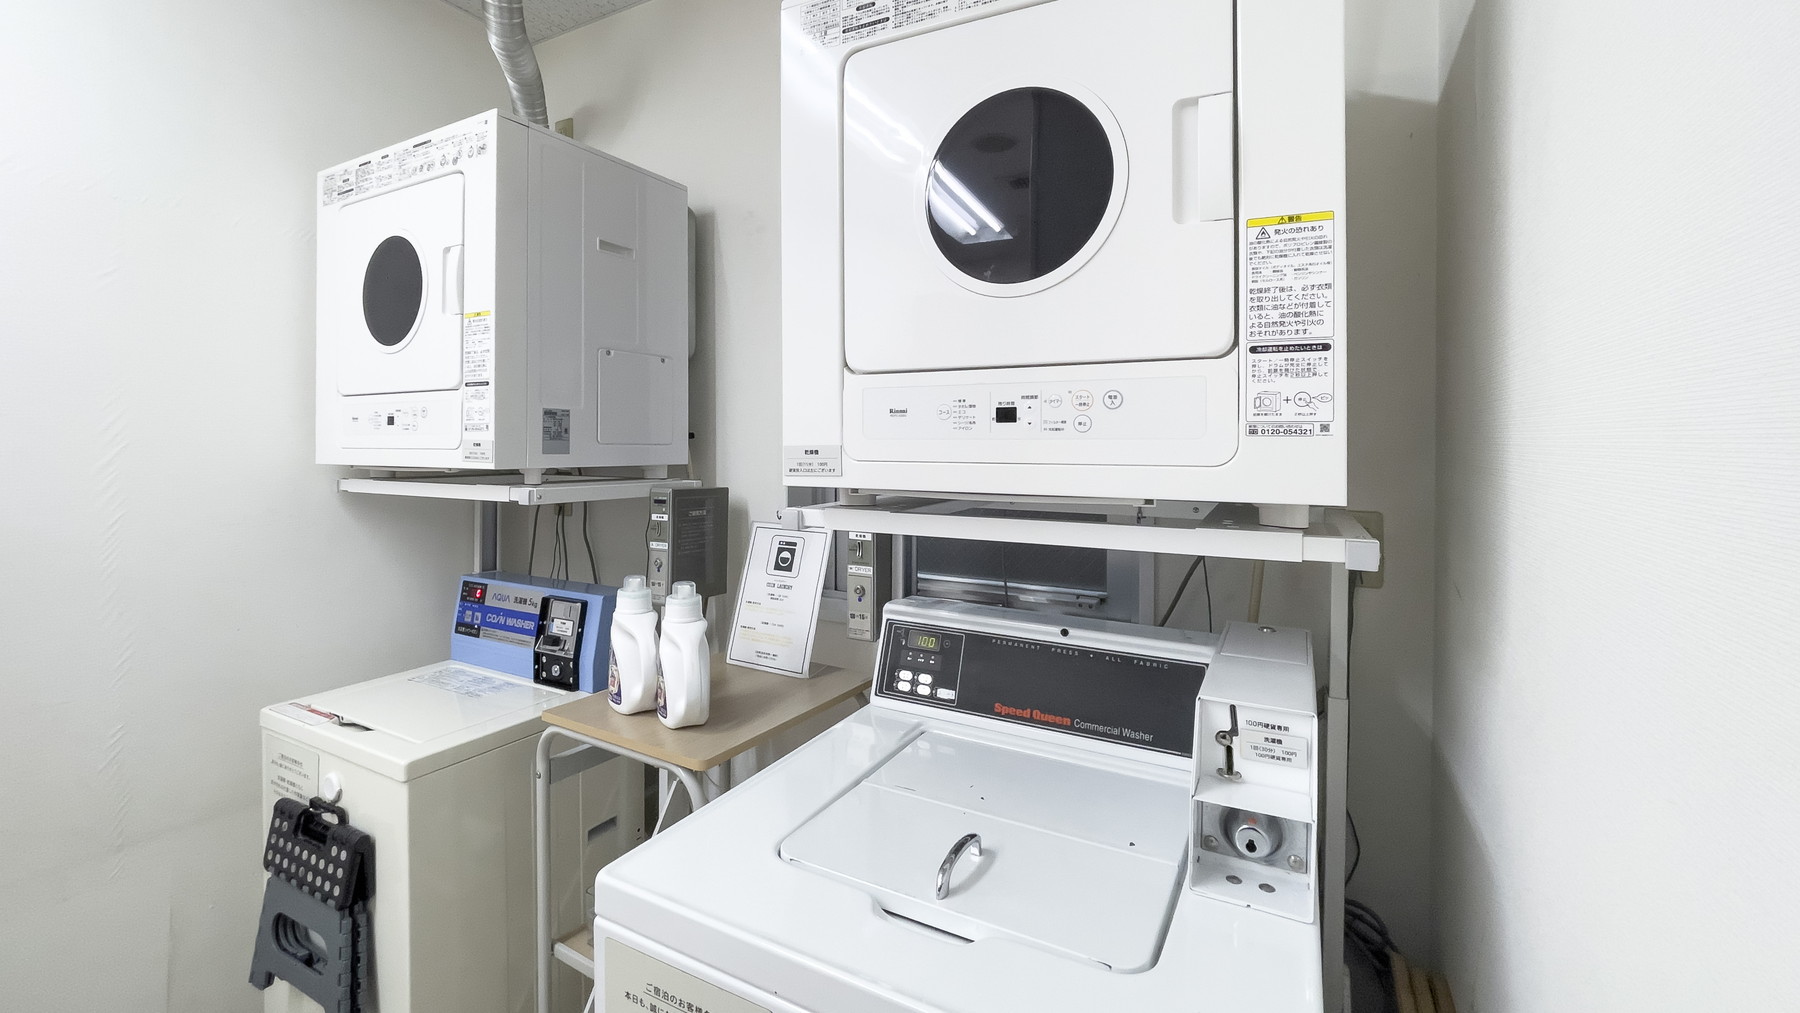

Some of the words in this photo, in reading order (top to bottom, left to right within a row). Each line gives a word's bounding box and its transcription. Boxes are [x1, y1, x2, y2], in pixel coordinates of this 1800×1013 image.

[1249, 283, 1332, 295] 乾燥終了後は、必ず衣類
[1249, 293, 1328, 304] を取り出してください。
[1249, 300, 1332, 312] 衣類に油などが付着して
[1249, 310, 1324, 320] いると、油の酸化熱に
[1249, 319, 1325, 329] よる自然発火や引火の
[1249, 328, 1312, 338] おそれがあります。
[492, 593, 511, 603] AQUA
[513, 596, 528, 606] 洗濯機
[486, 611, 506, 625] COIN
[506, 617, 535, 631] WASHER
[991, 638, 1041, 651] PERMANENT
[1051, 647, 1080, 657] PRESS
[1105, 655, 1122, 663] ALL
[1133, 659, 1169, 670] FABRIC
[994, 702, 1031, 719] Speed
[1032, 708, 1071, 726] Queen
[1073, 718, 1121, 735] Commercial
[1121, 726, 1154, 742] Washer
[1245, 719, 1290, 733] 100円硬貨専用
